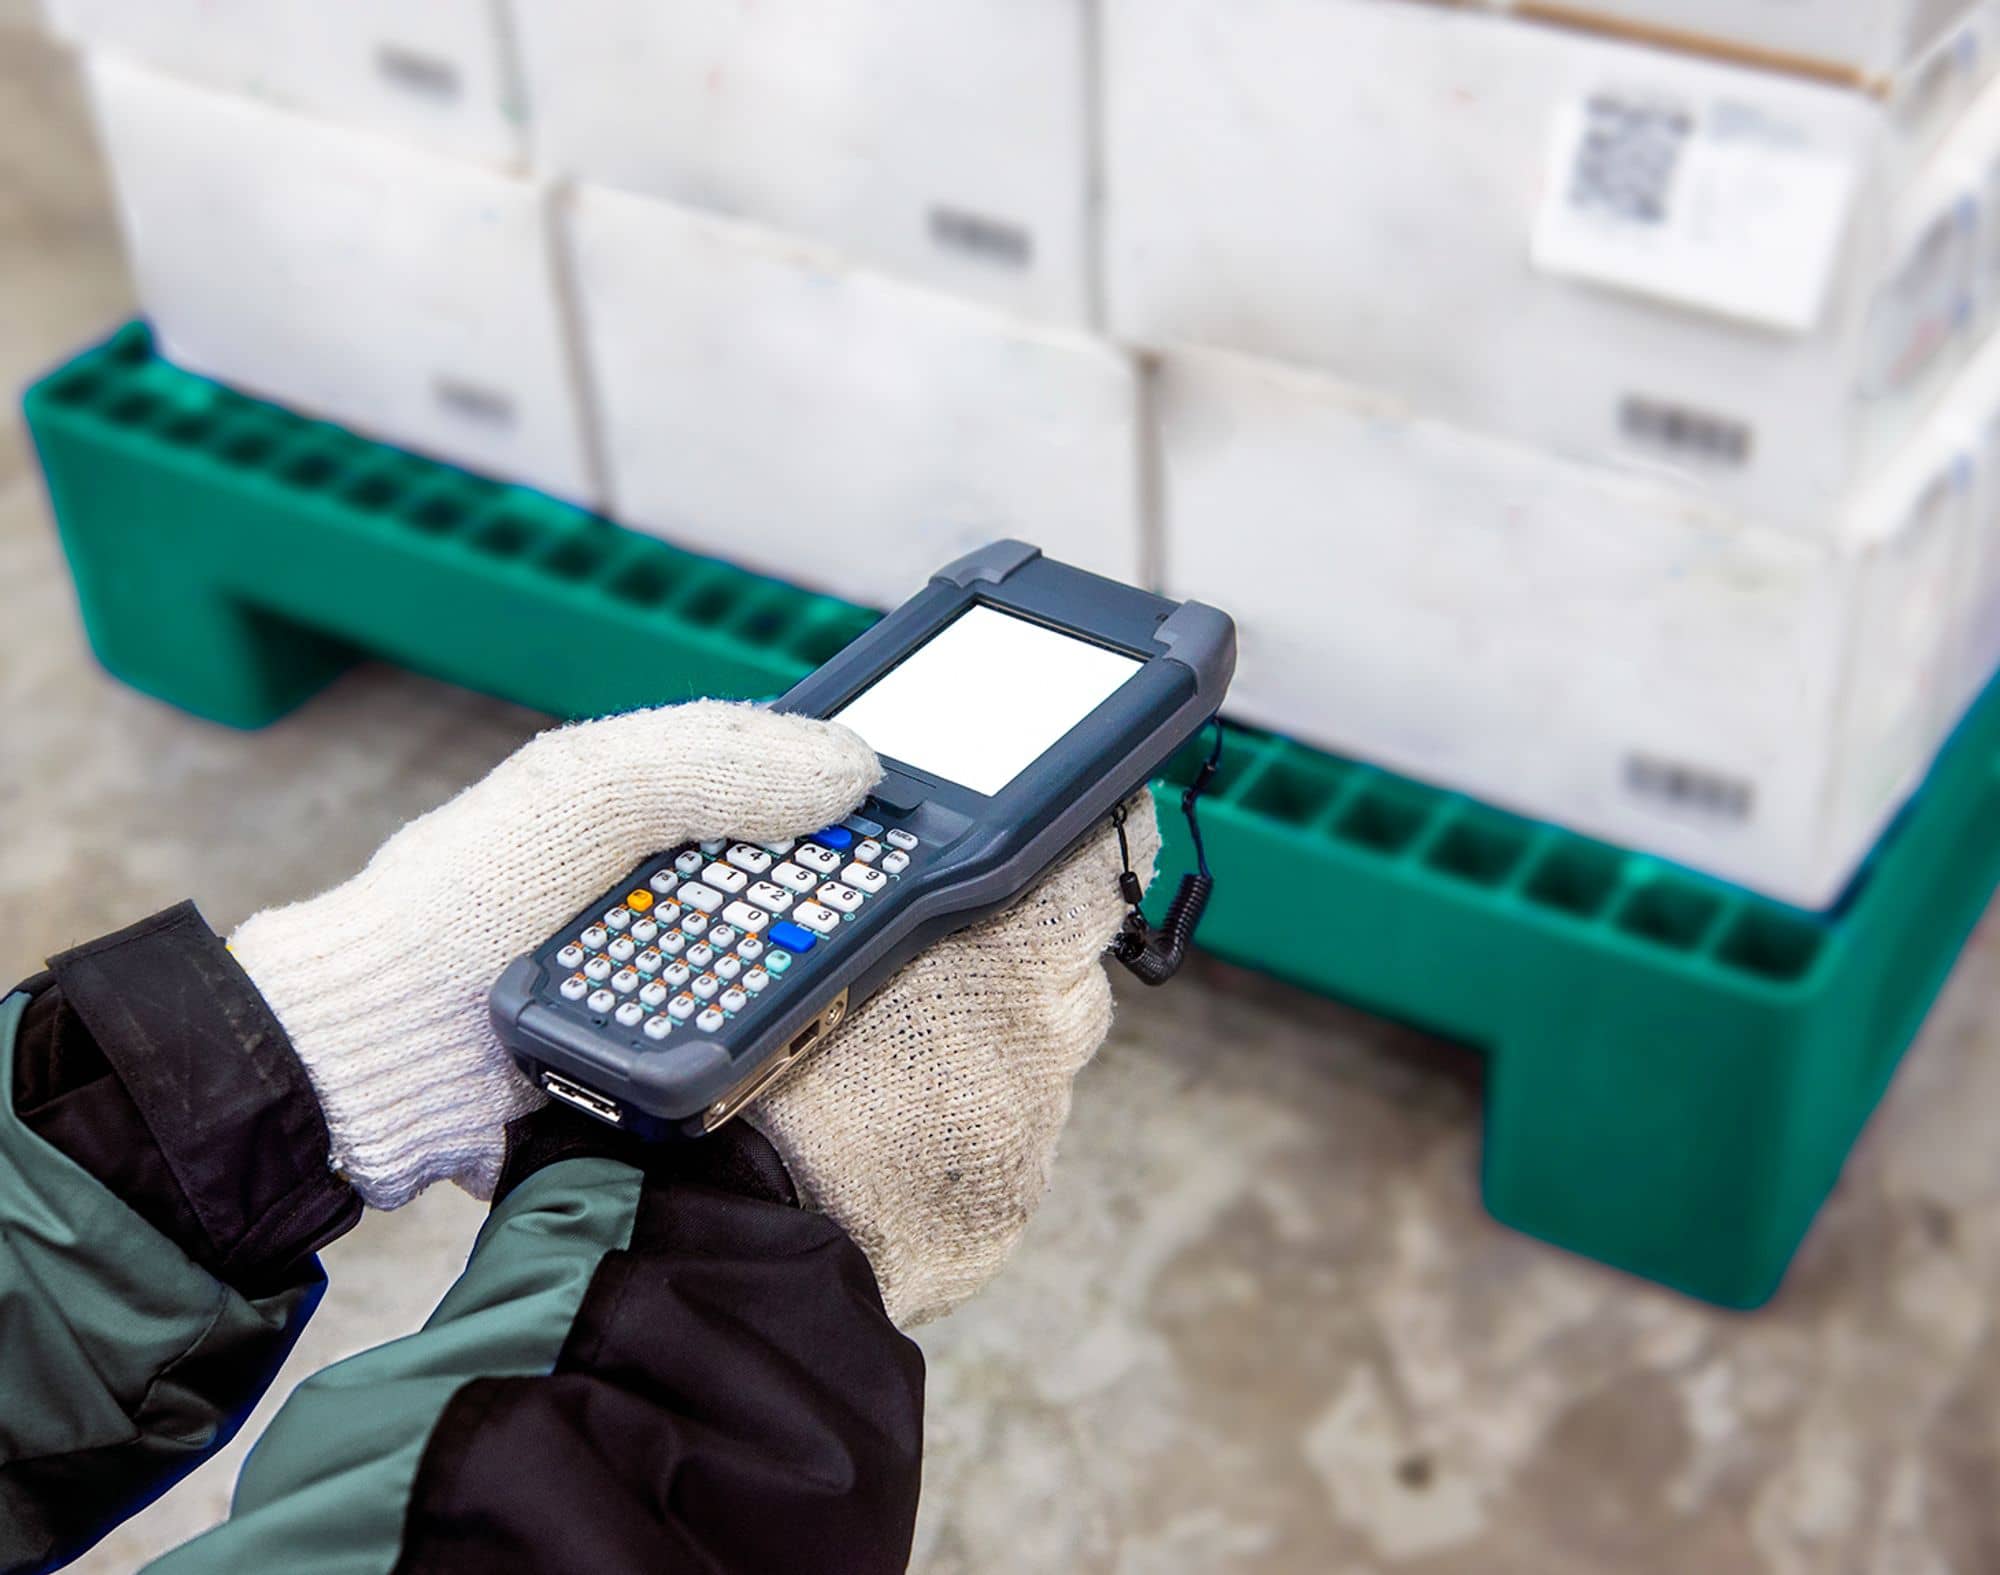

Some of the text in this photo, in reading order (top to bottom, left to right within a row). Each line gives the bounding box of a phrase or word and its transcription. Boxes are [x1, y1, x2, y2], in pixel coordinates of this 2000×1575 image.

[750, 851, 763, 860] 4
[796, 871, 811, 881] 5
[842, 891, 856, 901] 6
[819, 852, 880, 881] 8 9
[727, 871, 738, 880] 1
[770, 890, 786, 901] 2
[817, 911, 832, 921] 3
[748, 911, 761, 921] 0
[611, 909, 624, 917] E
[667, 933, 678, 941] G
[693, 946, 706, 954] H
[660, 903, 672, 911] A
[689, 914, 701, 922] B
[716, 927, 728, 935] C
[587, 928, 598, 936] K
[615, 940, 624, 948] L
[641, 952, 656, 961] M
[670, 965, 683, 973] N
[563, 947, 576, 956] Q
[591, 960, 604, 968] R
[676, 998, 688, 1006] U
[704, 1011, 718, 1019] V
[566, 979, 582, 987] W
